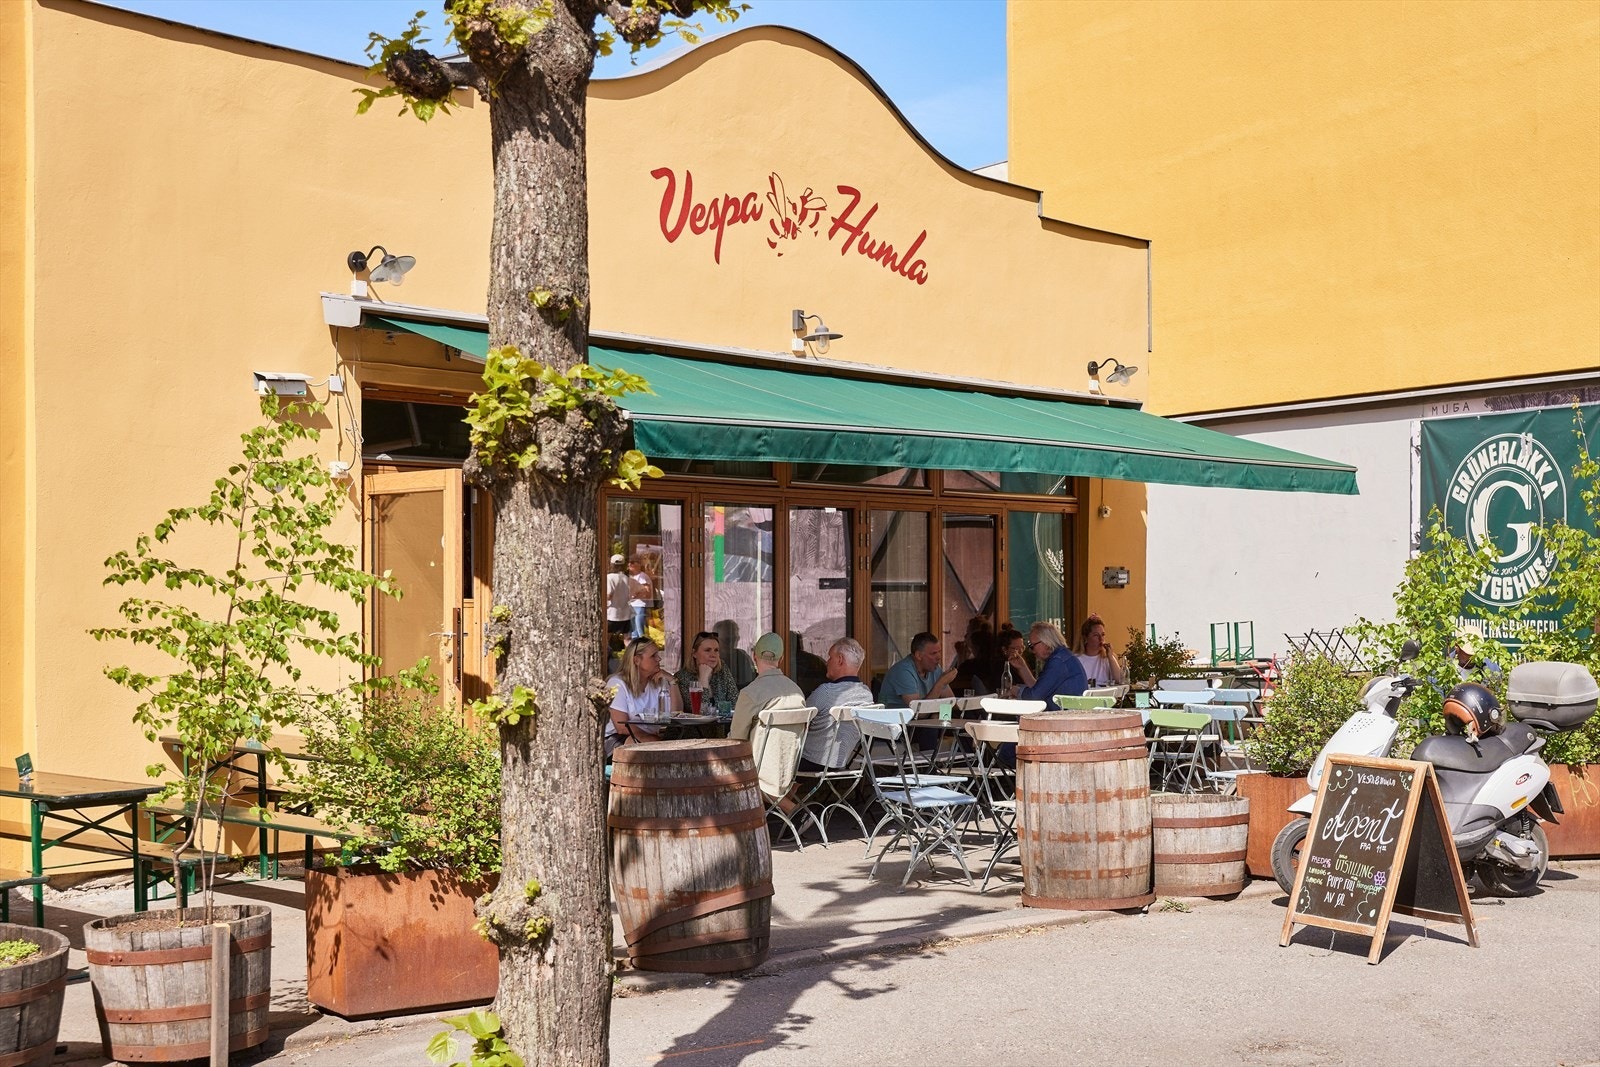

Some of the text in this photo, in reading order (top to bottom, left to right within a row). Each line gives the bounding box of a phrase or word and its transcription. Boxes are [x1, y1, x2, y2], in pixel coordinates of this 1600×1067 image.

[650, 167, 928, 285] Vespa Humla
[1431, 401, 1470, 416] MUGA
[1471, 480, 1537, 563] G
[1335, 858, 1375, 880] UTSTILLING
[1324, 891, 1335, 904] AV
